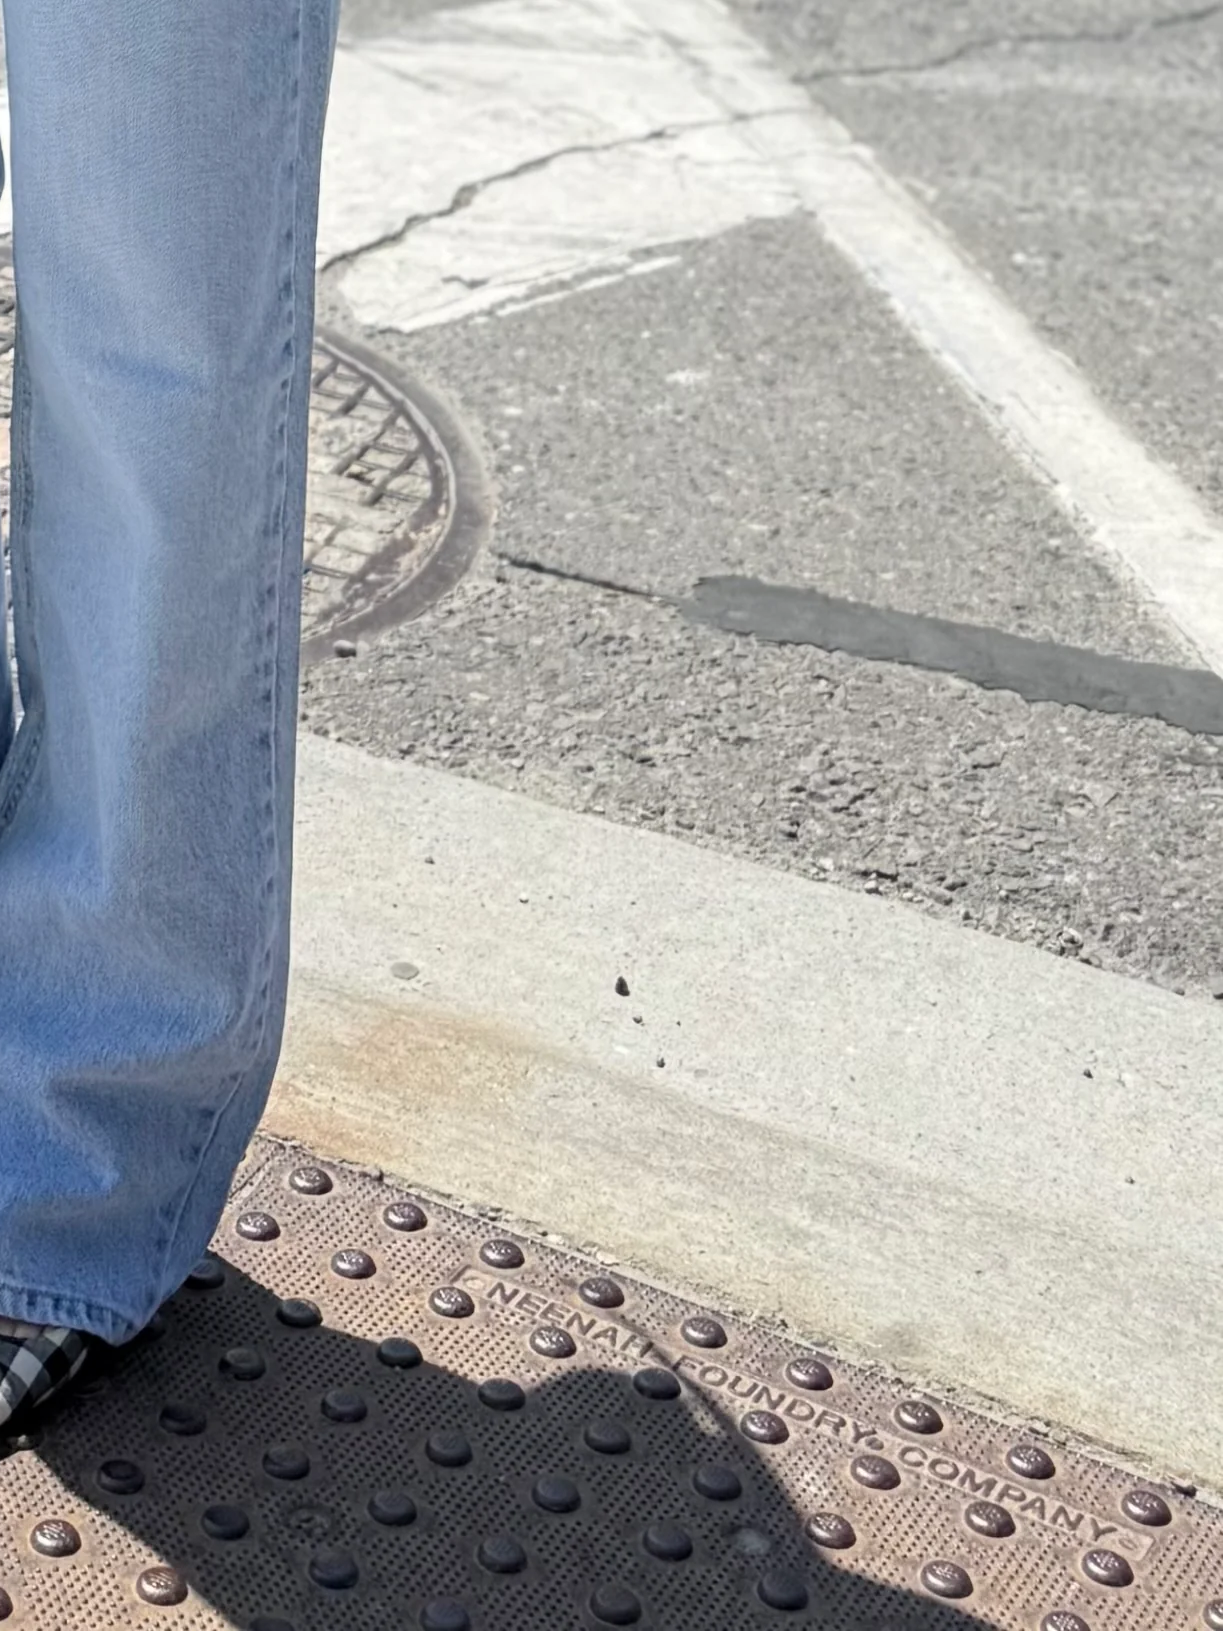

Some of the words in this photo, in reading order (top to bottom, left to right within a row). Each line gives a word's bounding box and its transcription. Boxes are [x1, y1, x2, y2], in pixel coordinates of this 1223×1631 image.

[486, 1281, 654, 1358] NEENAH
[672, 1354, 878, 1444] FOUNDRY
[897, 1445, 1118, 1542] COMPANY
